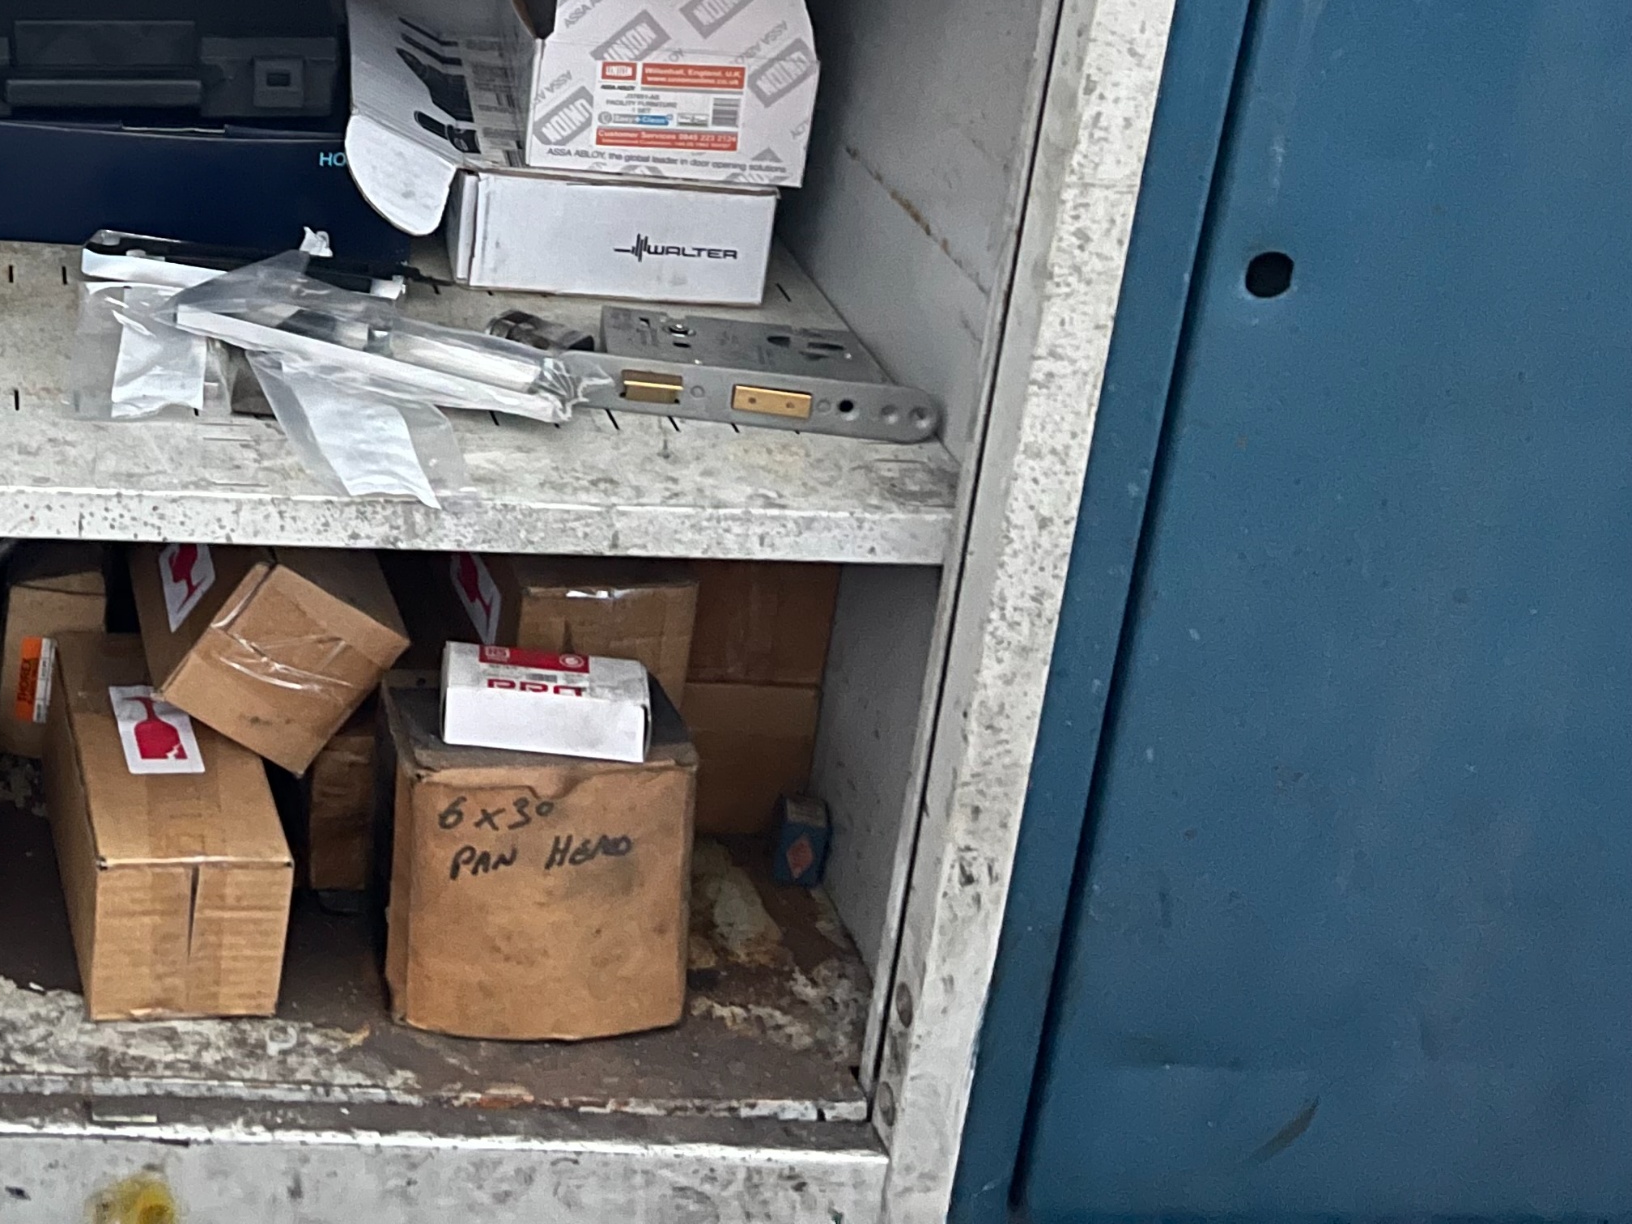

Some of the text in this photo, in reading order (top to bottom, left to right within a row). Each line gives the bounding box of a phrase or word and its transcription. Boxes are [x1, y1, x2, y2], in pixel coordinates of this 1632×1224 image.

[564, 3, 592, 29] ASSA
[541, 98, 592, 143] UNION
[547, 148, 572, 156] ASSA
[712, 161, 747, 172] opening
[748, 164, 787, 174] solutions
[647, 245, 738, 260] WALTER
[450, 844, 518, 881] PAN
